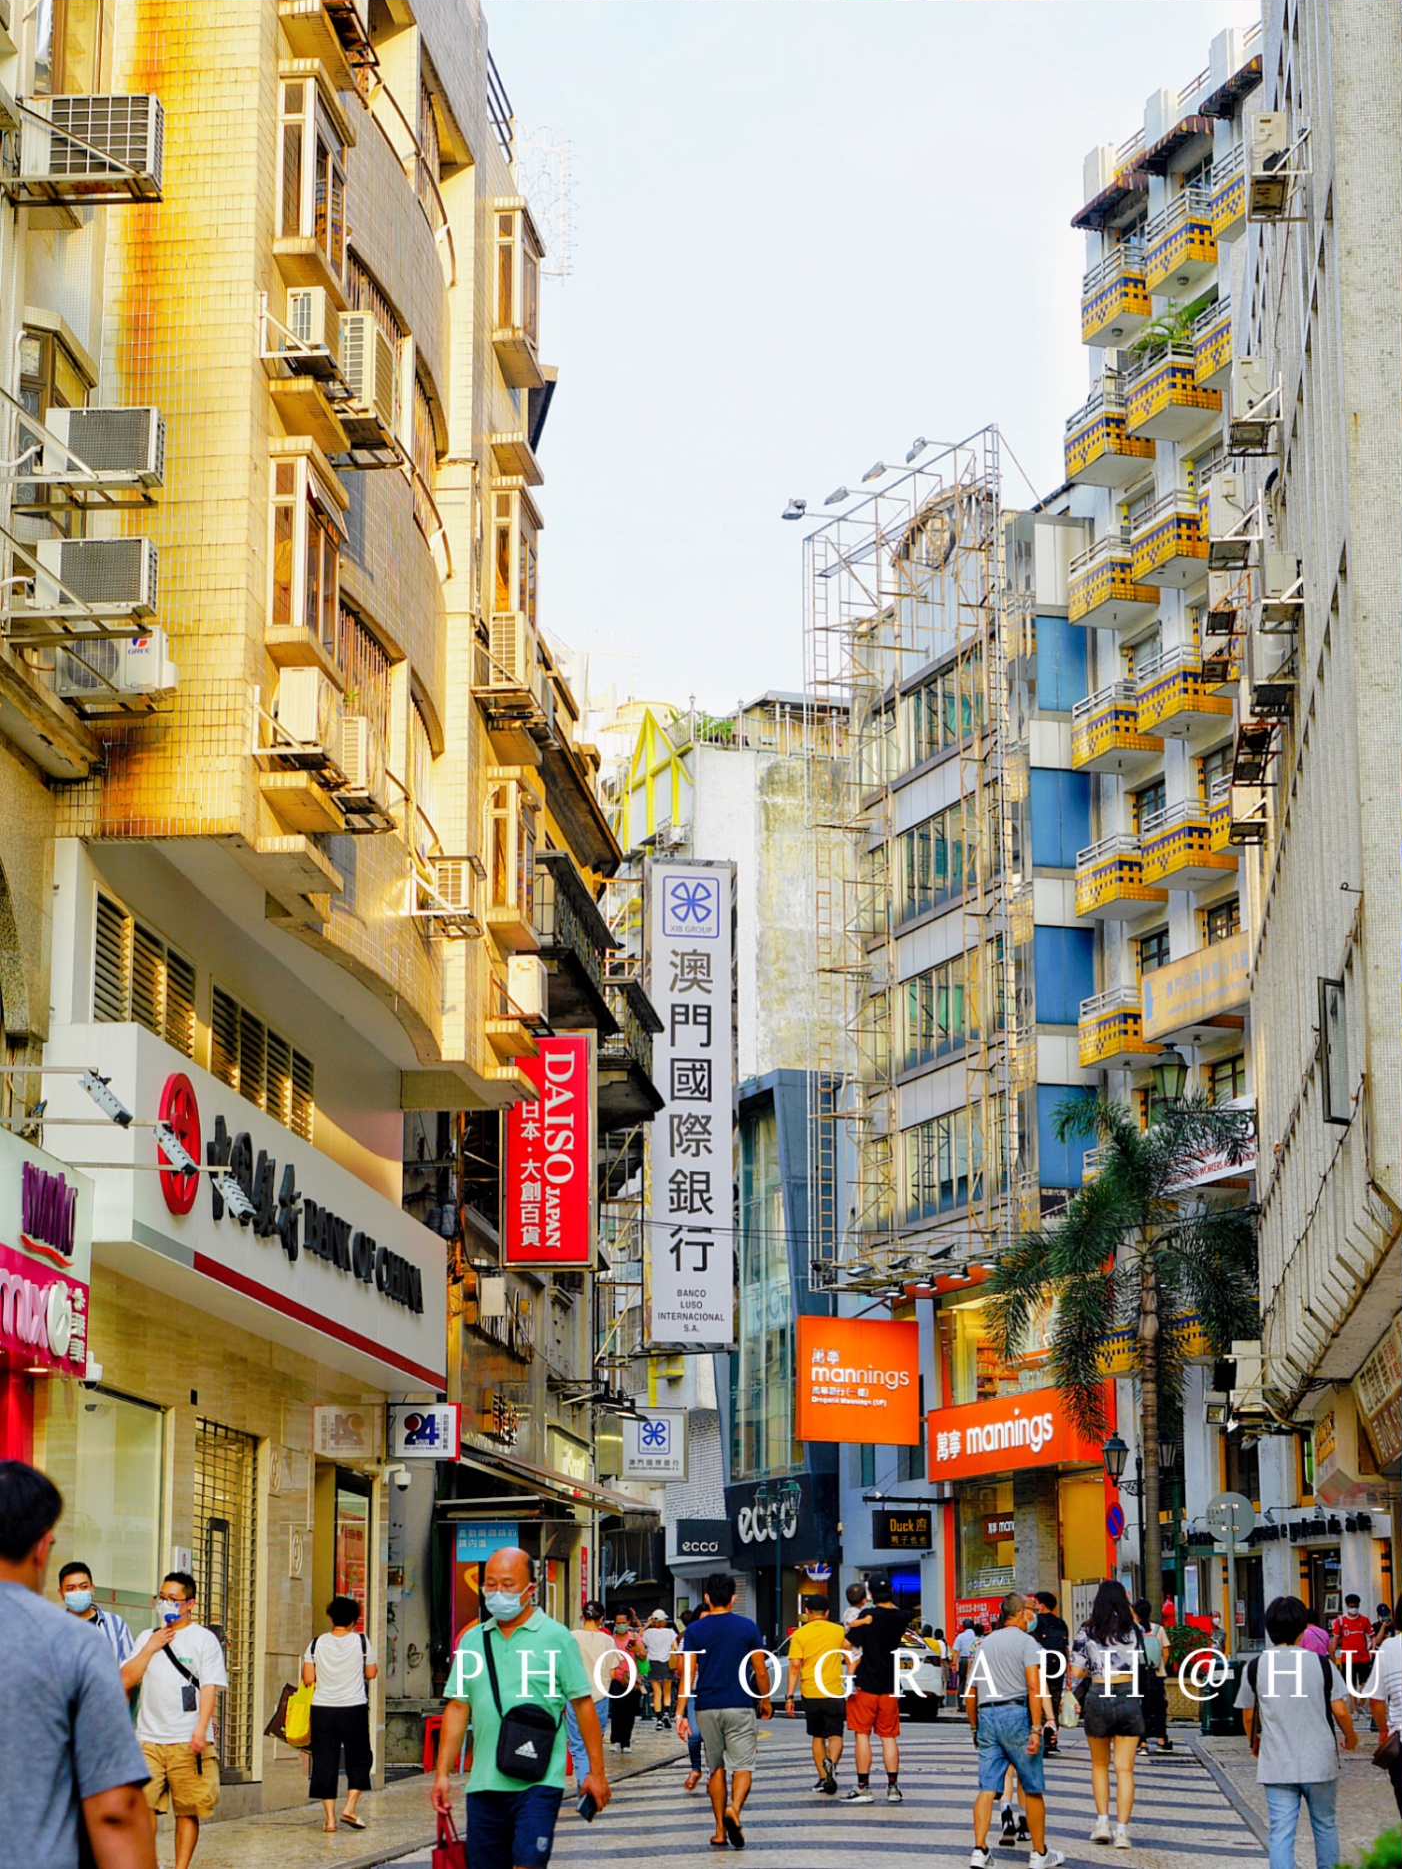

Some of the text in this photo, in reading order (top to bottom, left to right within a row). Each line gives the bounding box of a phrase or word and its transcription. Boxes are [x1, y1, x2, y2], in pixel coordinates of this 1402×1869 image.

[127, 647, 151, 655] GREE
[669, 924, 713, 934] XIB GROUP
[667, 948, 715, 1273] 澳門國際銀行
[543, 1050, 576, 1248] DAISO JAPAN
[302, 1198, 425, 1315] BANK OF CHINA
[676, 1289, 707, 1299] BANCO
[679, 1301, 704, 1310] LUSO
[657, 1311, 726, 1322] INTERNACIONAL
[683, 1323, 701, 1333] S.A.
[812, 1347, 840, 1365] 萬寧
[811, 1364, 910, 1391] mannings
[404, 1412, 440, 1446] 24
[965, 1407, 1054, 1453] mannings
[936, 1429, 962, 1463] 萬寧
[889, 1518, 914, 1533] Duck
[682, 1540, 719, 1553] ecco
